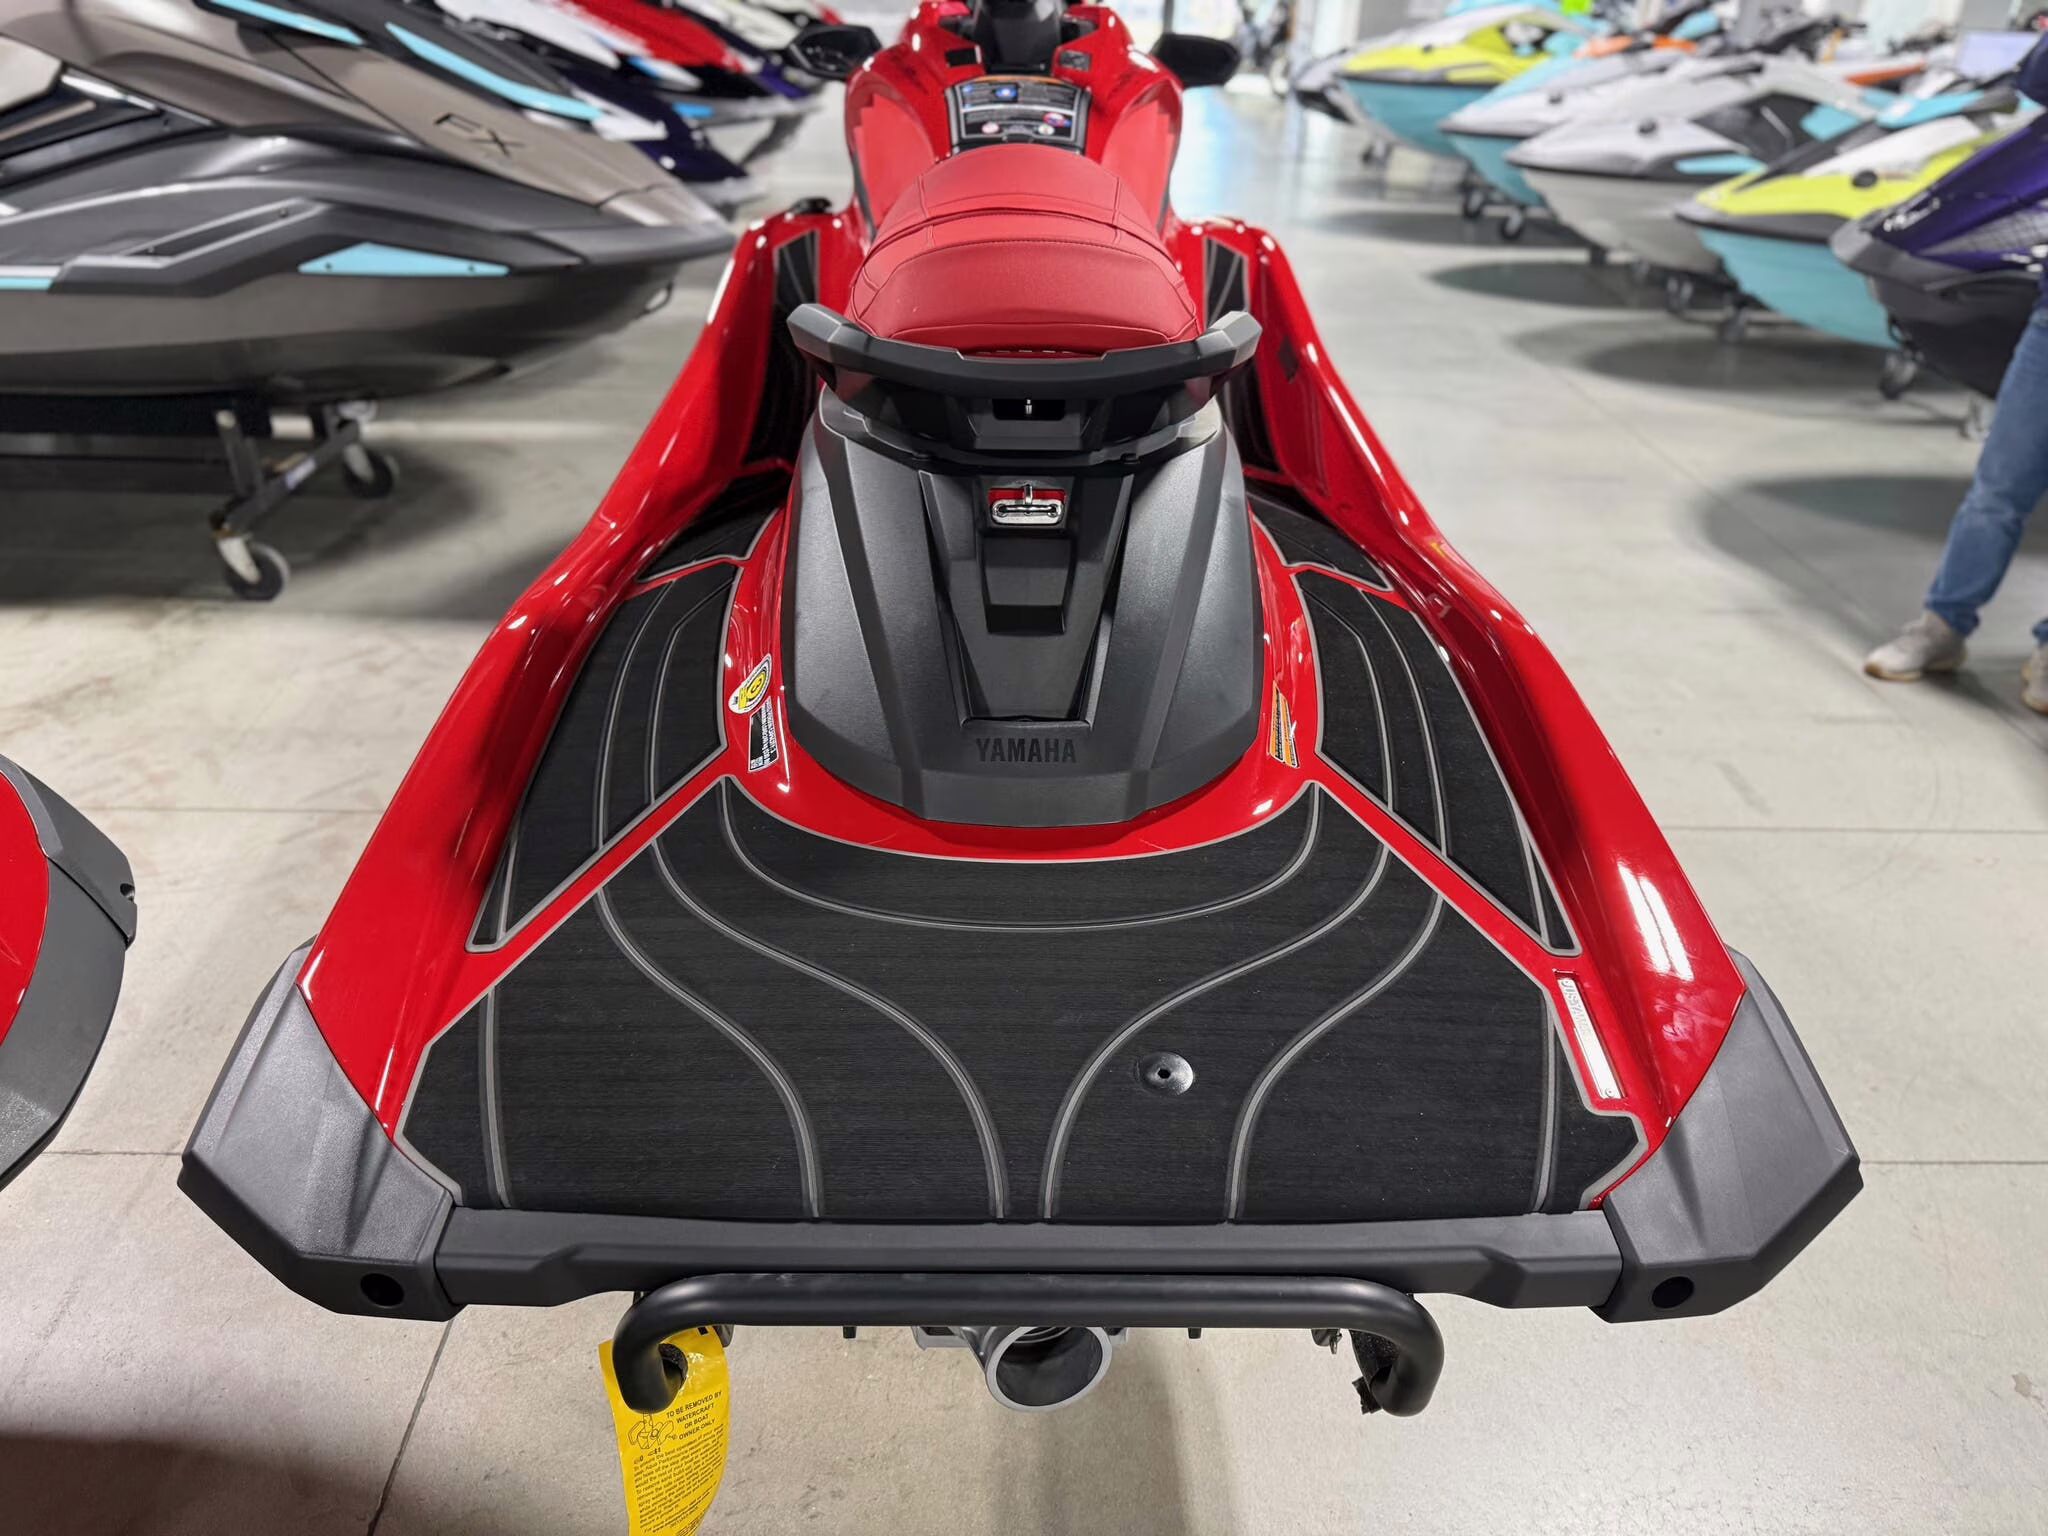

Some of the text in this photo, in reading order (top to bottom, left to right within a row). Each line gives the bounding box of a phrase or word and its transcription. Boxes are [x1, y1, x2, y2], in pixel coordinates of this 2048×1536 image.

[976, 737, 1077, 763] YAMAHA
[676, 1402, 714, 1423] WATERCRAFT
[685, 1395, 713, 1410] REMOVED
[679, 1426, 700, 1440] OWNER
[700, 1418, 715, 1428] ONLY
[694, 1414, 708, 1424] BOAT
